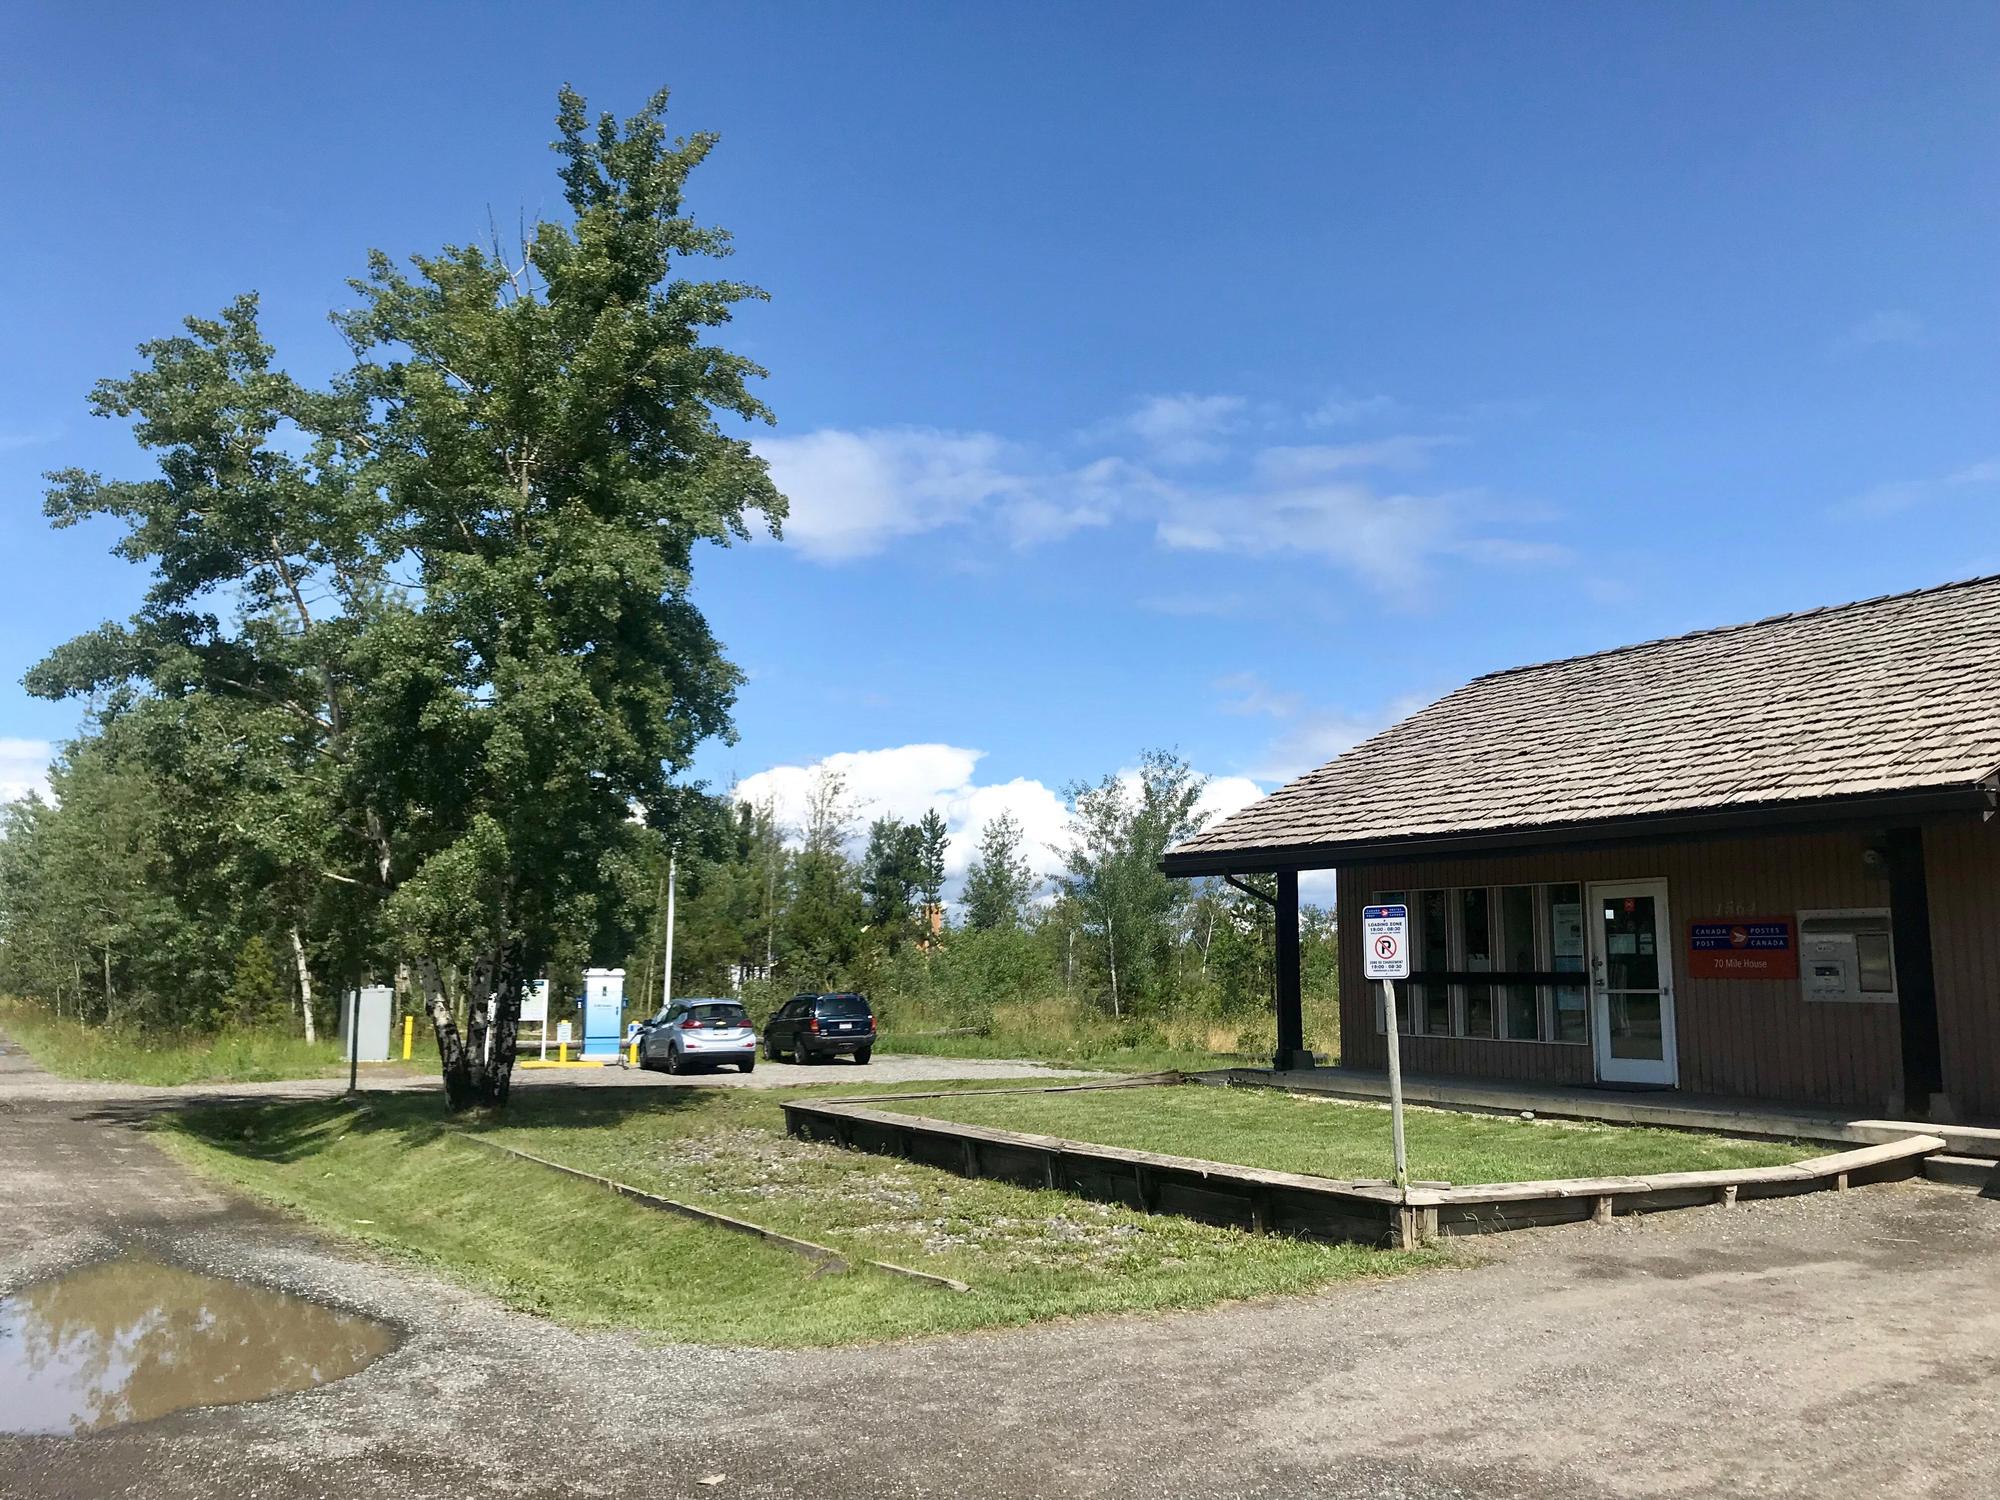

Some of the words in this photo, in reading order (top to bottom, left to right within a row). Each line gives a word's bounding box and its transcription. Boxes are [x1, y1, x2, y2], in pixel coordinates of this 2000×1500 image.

[1714, 958, 1724, 968] 70
[1726, 958, 1742, 968] Mile
[1744, 958, 1768, 968] House
